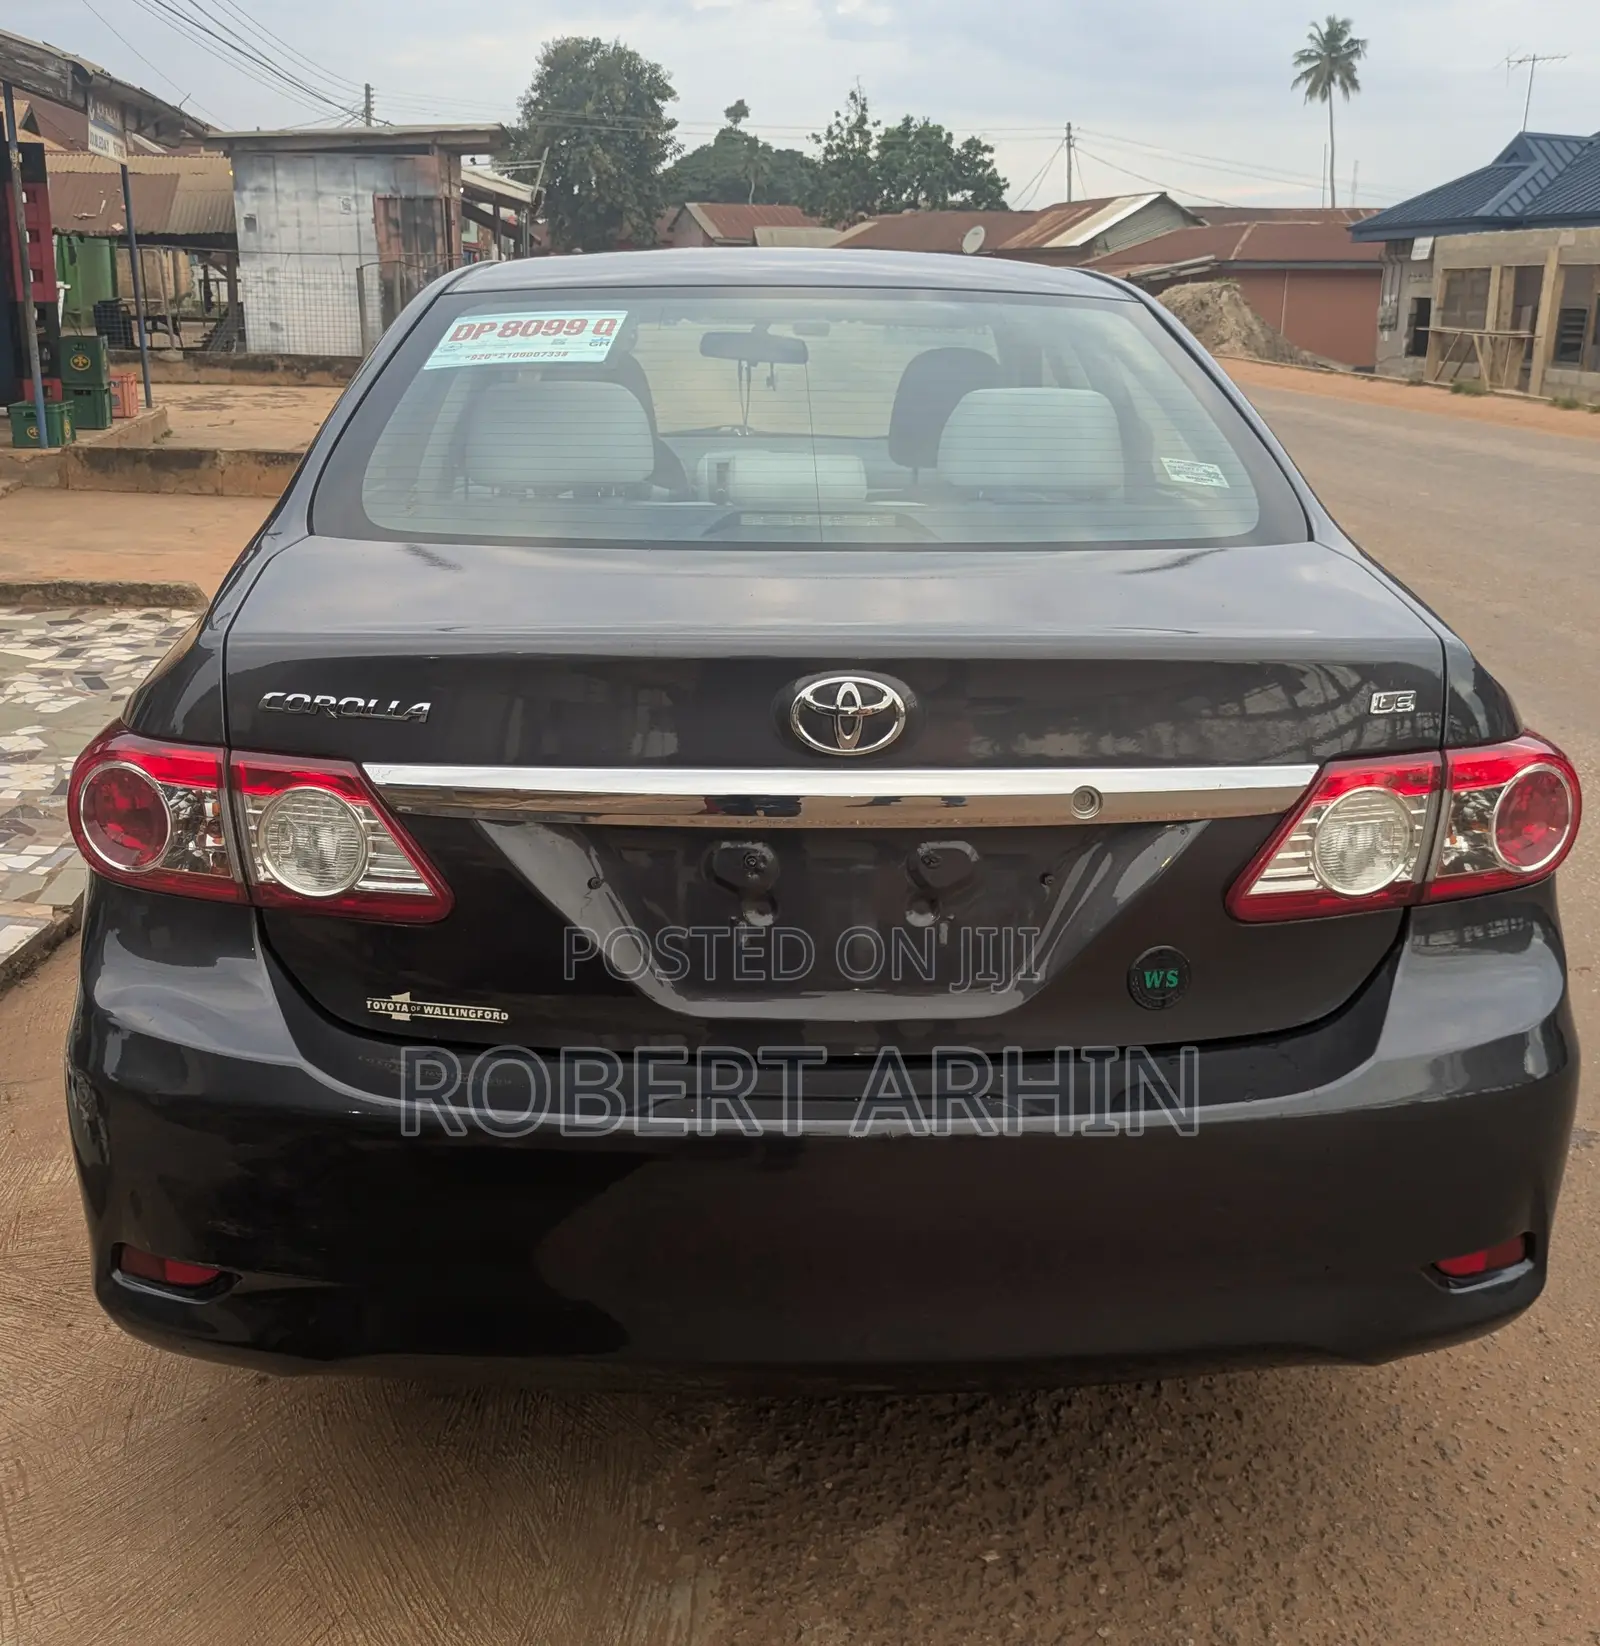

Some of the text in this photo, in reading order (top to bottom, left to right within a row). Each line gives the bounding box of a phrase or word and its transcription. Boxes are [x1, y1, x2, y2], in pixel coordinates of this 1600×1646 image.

[448, 318, 618, 342] DP 8099 Q
[258, 692, 432, 723] COROLLA
[1370, 690, 1417, 714] LE
[1144, 969, 1179, 989] WS
[366, 1000, 409, 1012] TOYOTA
[423, 1005, 509, 1021] WALLINGFORD
